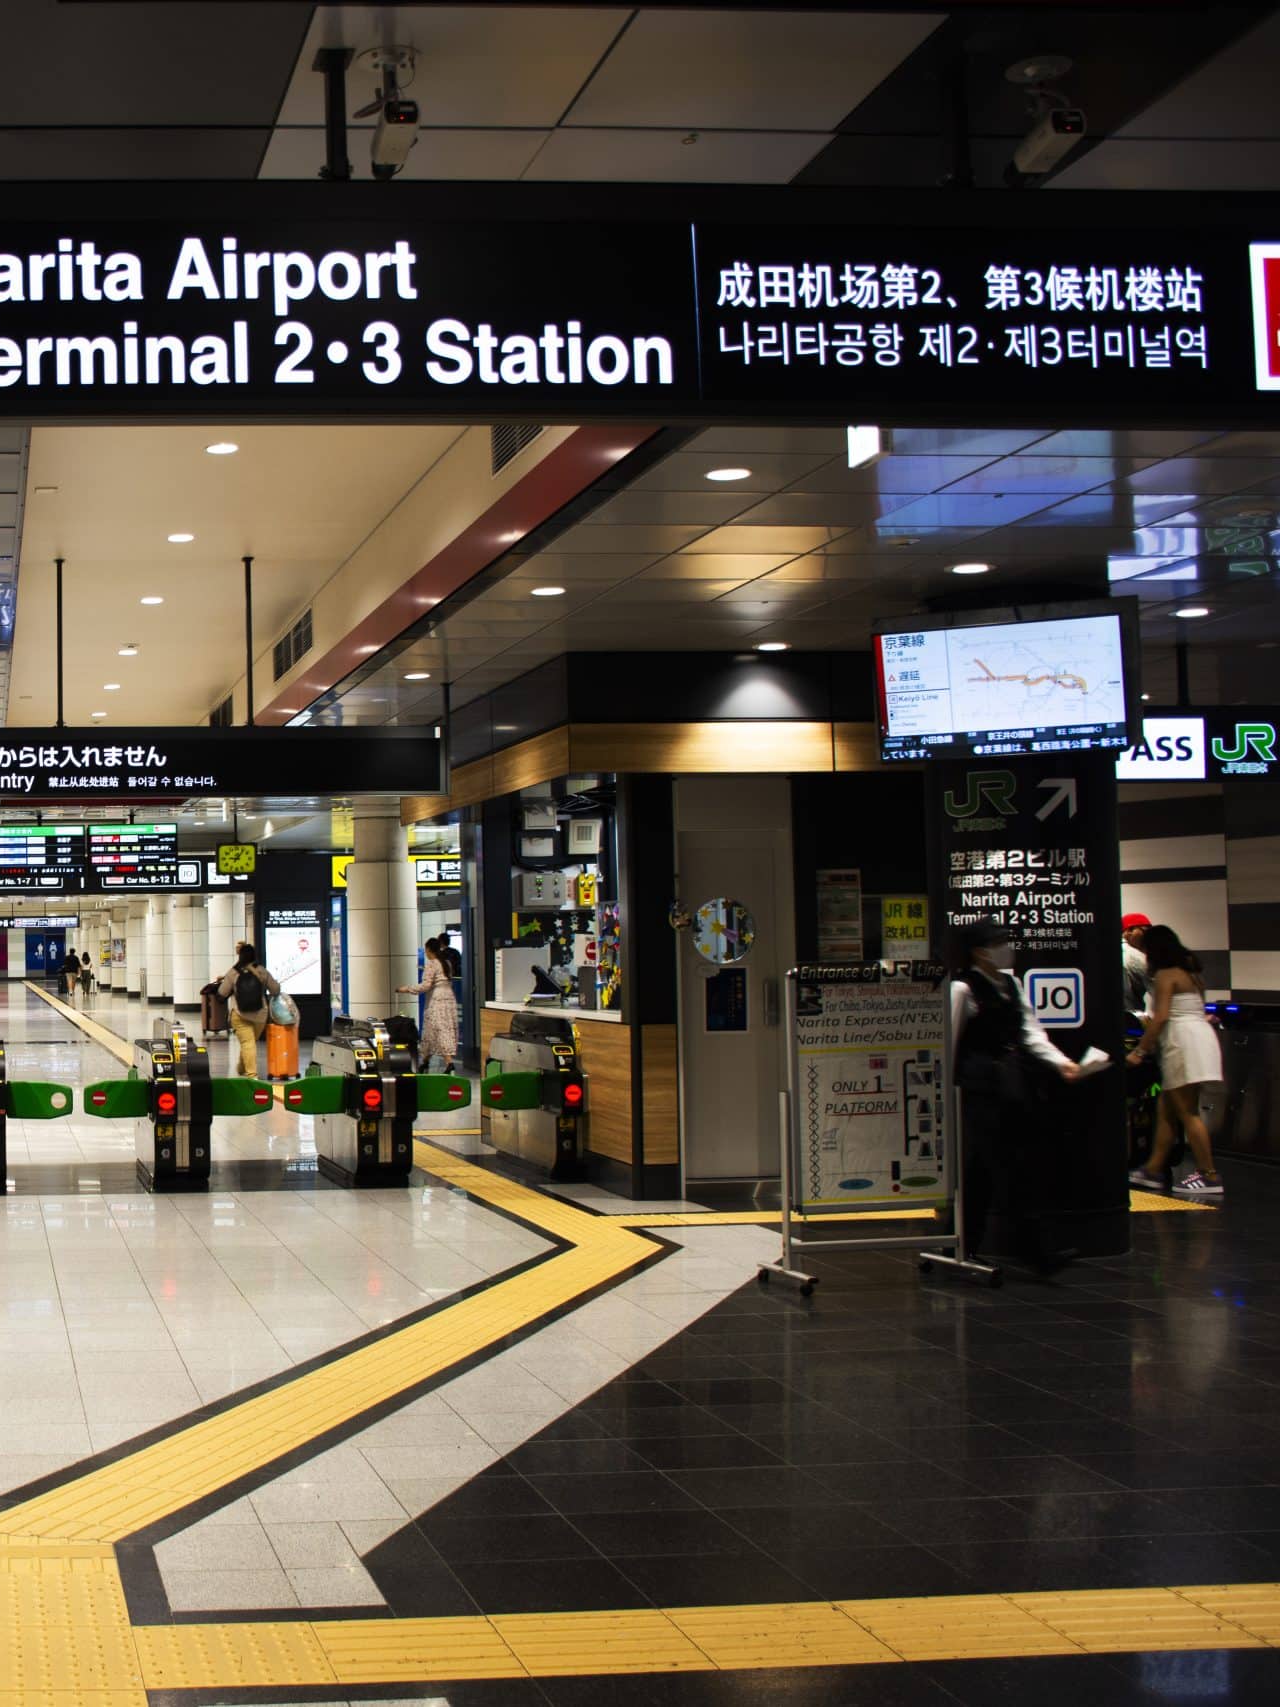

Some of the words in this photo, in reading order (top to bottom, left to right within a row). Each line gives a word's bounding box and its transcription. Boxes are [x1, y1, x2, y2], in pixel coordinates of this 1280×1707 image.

[167, 236, 417, 315] Airport
[425, 319, 673, 385] Station
[718, 321, 904, 367] 나리타공항
[918, 323, 1208, 369] 제2·제3터미널역
[884, 634, 926, 649] 京葉線
[1117, 735, 1193, 761] ASS
[1212, 723, 1278, 761] JR
[943, 769, 1019, 817] JR
[949, 847, 1086, 871] 空港第2ビル駅
[962, 893, 1010, 907] Narita
[1014, 891, 1076, 908] Airport
[886, 903, 902, 918] JR
[1043, 908, 1094, 924] Station
[799, 964, 859, 982] Entrance
[862, 962, 880, 982] of
[882, 961, 912, 977] JR
[1036, 985, 1073, 1010] JO
[796, 1017, 840, 1029] Narita
[797, 1033, 839, 1046] Narita
[843, 1029, 913, 1045] Line/Sobu
[917, 1028, 943, 1041] Line
[832, 1081, 868, 1093] ONLY
[825, 1101, 898, 1114] PLATFORM
